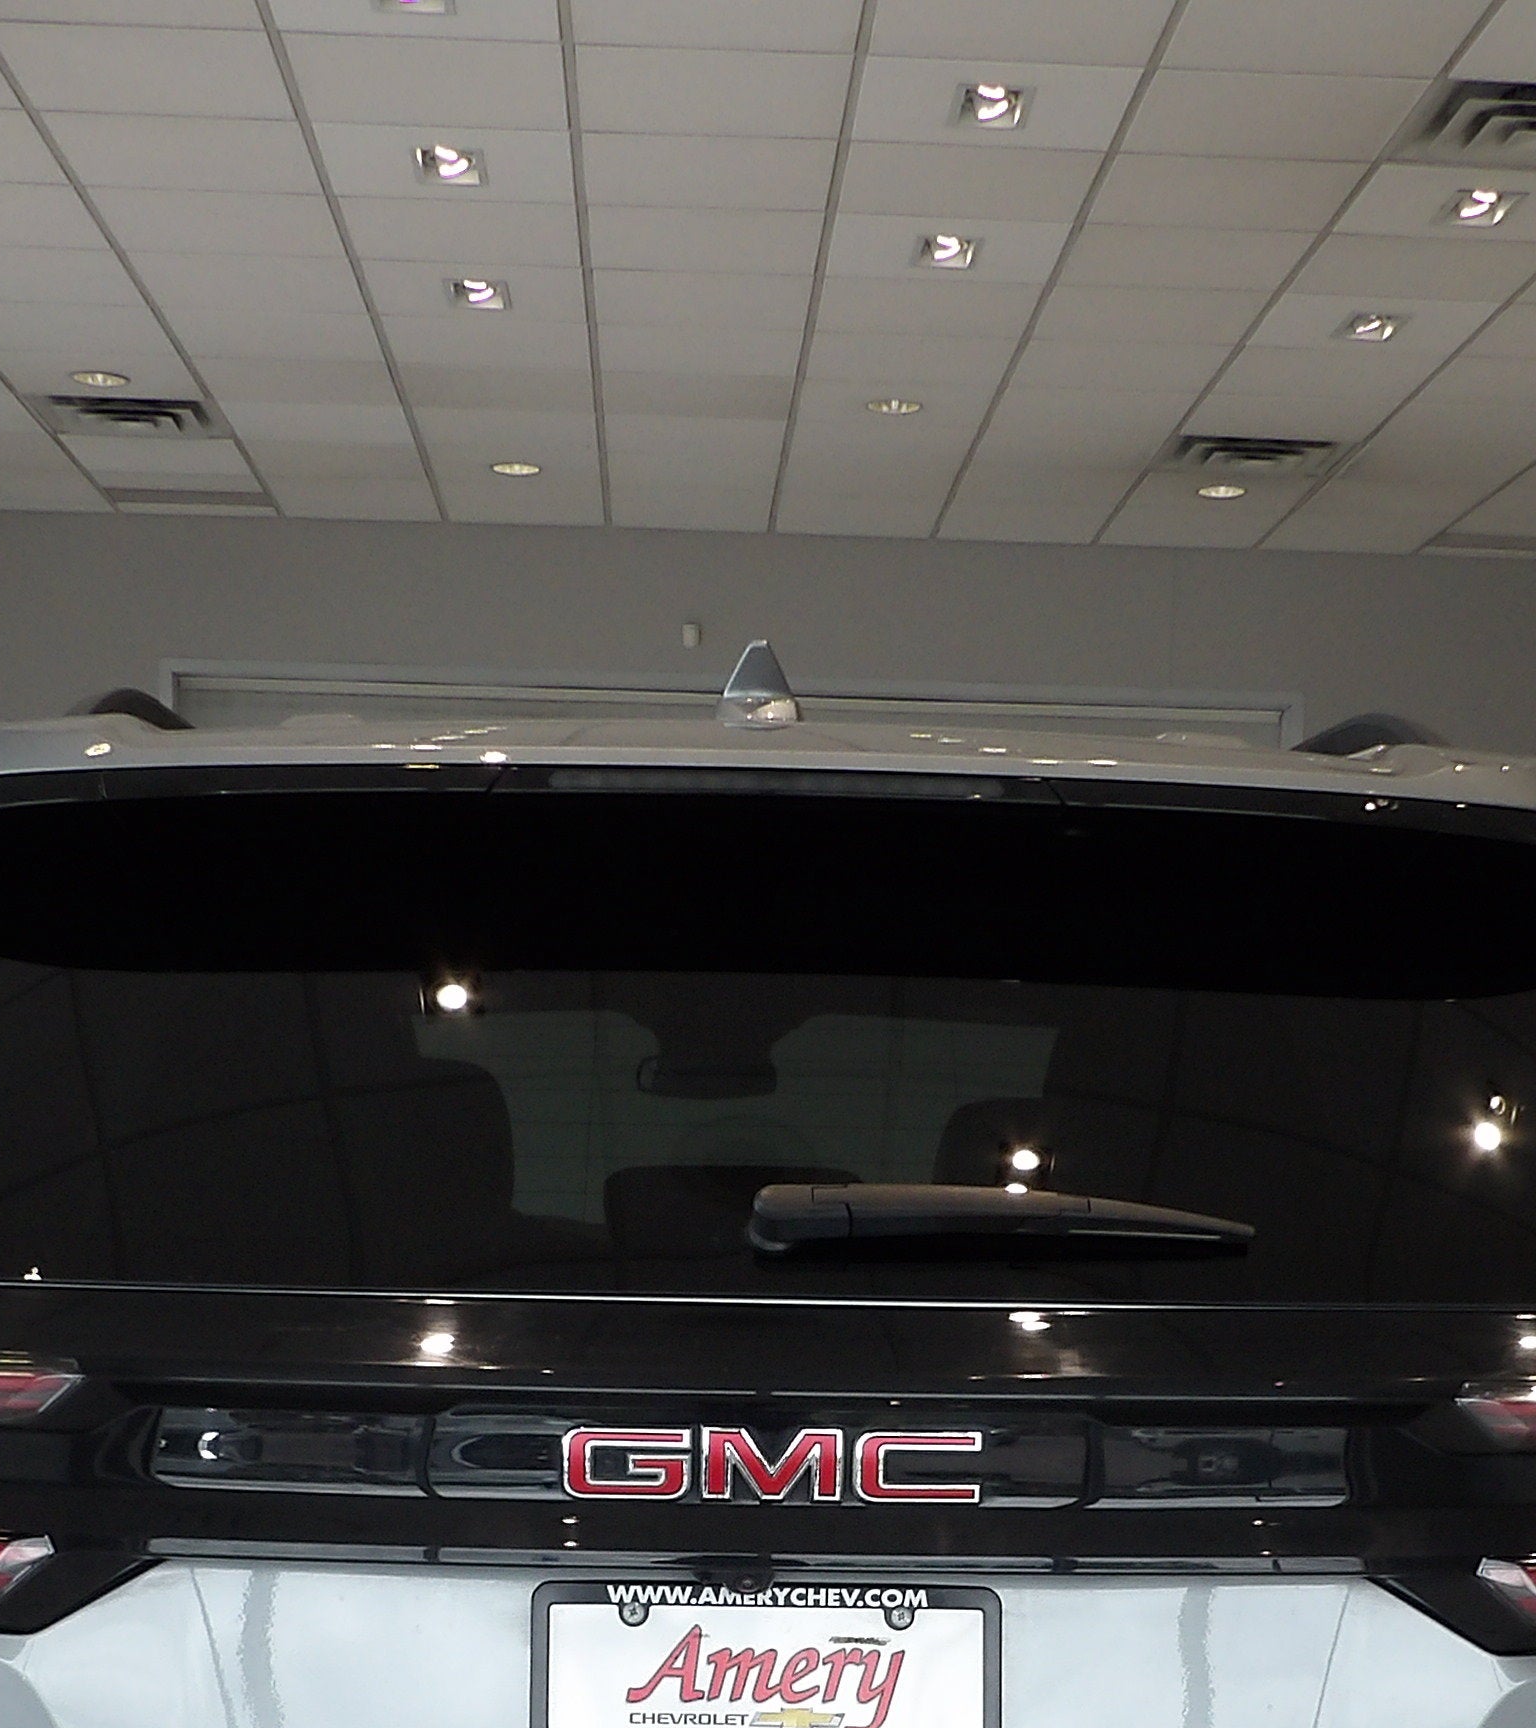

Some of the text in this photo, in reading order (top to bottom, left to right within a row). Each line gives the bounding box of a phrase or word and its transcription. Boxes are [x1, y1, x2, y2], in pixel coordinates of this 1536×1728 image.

[562, 1427, 983, 1503] GMC
[607, 1585, 929, 1608] WWW.AMERYCHEV.COM
[628, 1711, 749, 1727] CHEVROLET
